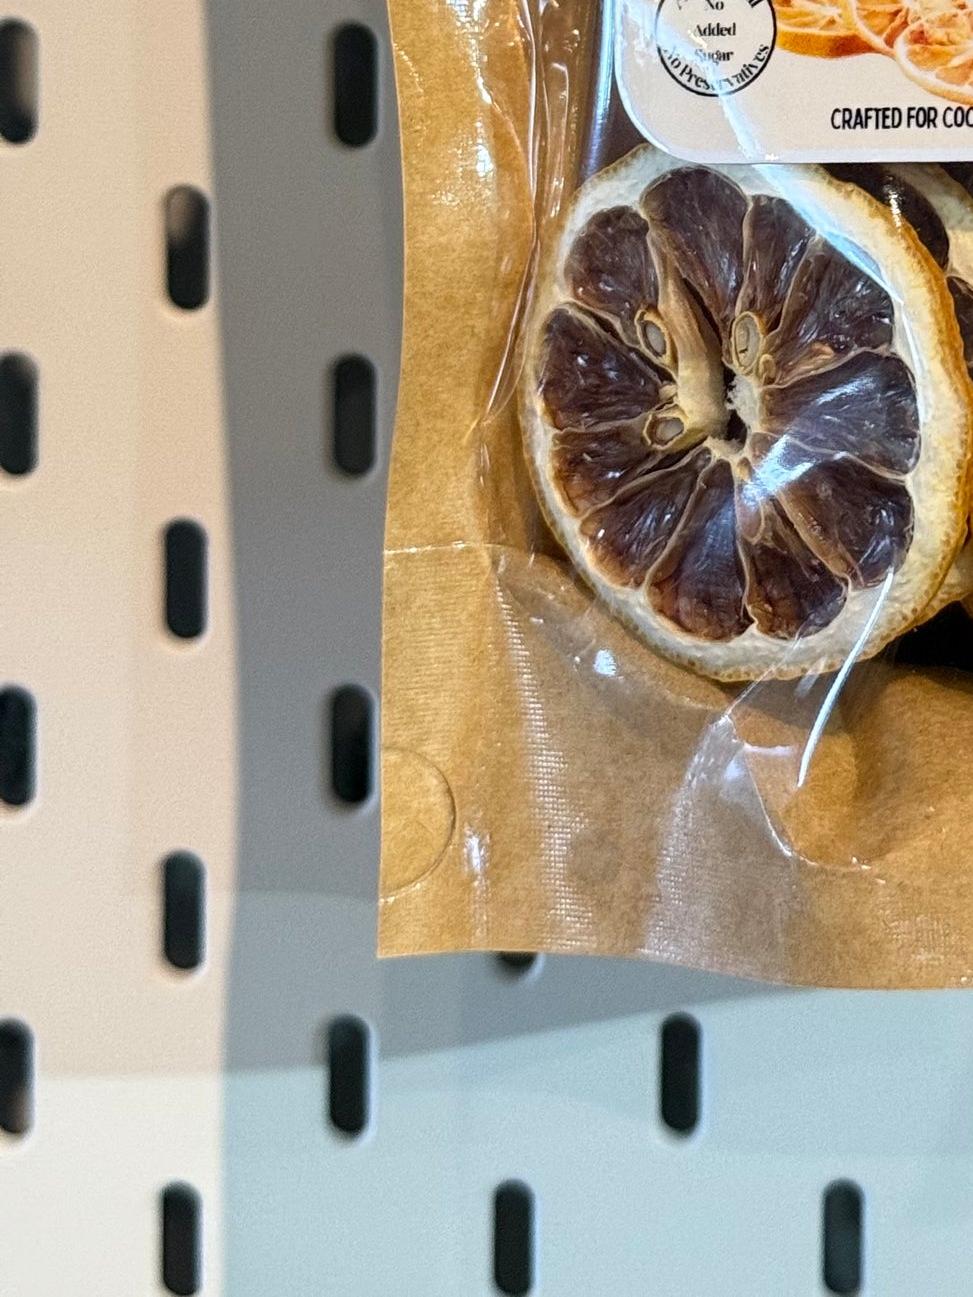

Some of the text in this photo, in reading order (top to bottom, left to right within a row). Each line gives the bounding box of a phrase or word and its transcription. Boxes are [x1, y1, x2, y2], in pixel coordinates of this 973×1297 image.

[694, 22, 736, 37] Added
[695, 48, 734, 66] Sugar
[831, 107, 901, 130] CRAFTED
[907, 107, 937, 128] FOR
